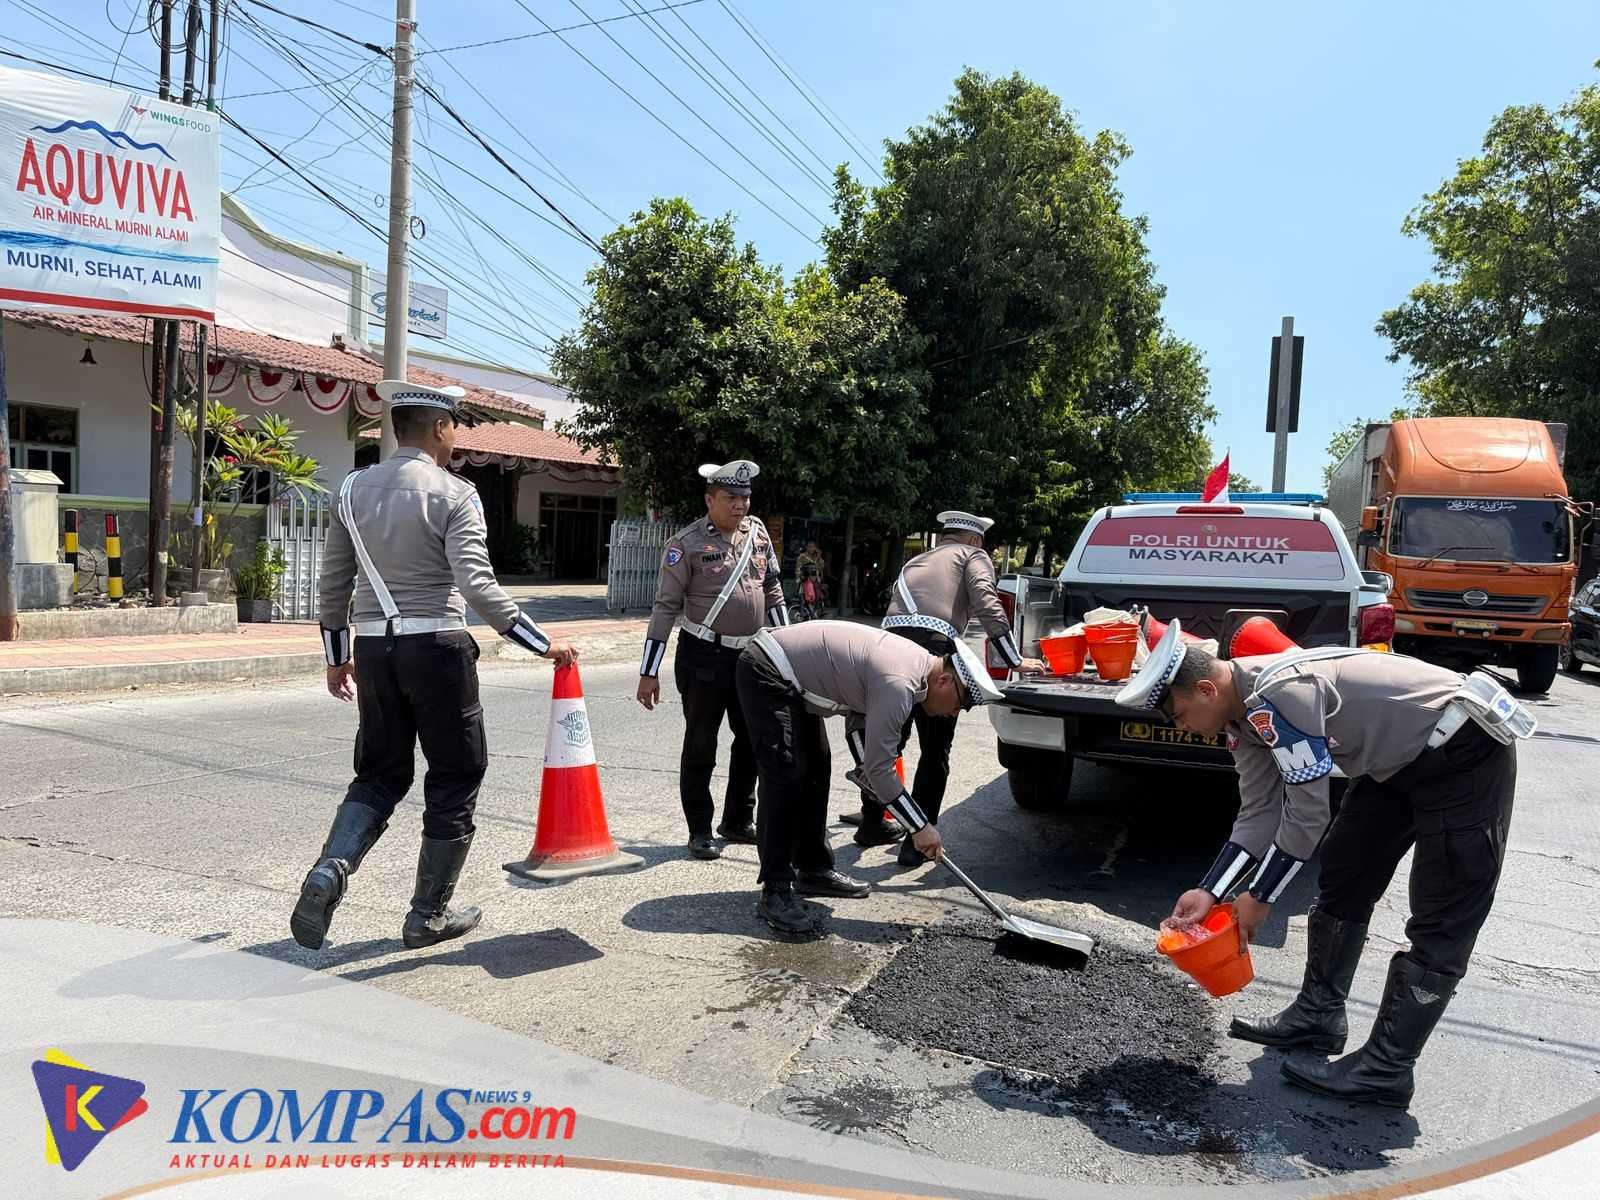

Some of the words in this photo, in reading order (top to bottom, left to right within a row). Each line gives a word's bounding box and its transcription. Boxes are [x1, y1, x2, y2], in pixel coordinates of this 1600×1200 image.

[17, 137, 194, 222] AQUVIVA
[33, 205, 54, 221] AIR
[57, 212, 112, 231] MINERAL
[115, 219, 151, 236] MURNI
[155, 227, 189, 242] ALAMI
[7, 249, 79, 277] MURNI,
[85, 260, 147, 285] SEHAT,
[152, 270, 202, 290] ALAMI
[1129, 534, 1198, 547] POLRI
[1206, 535, 1289, 549] UNTUK
[1129, 548, 1288, 564] MASYARAKAT
[1271, 739, 1318, 772] M
